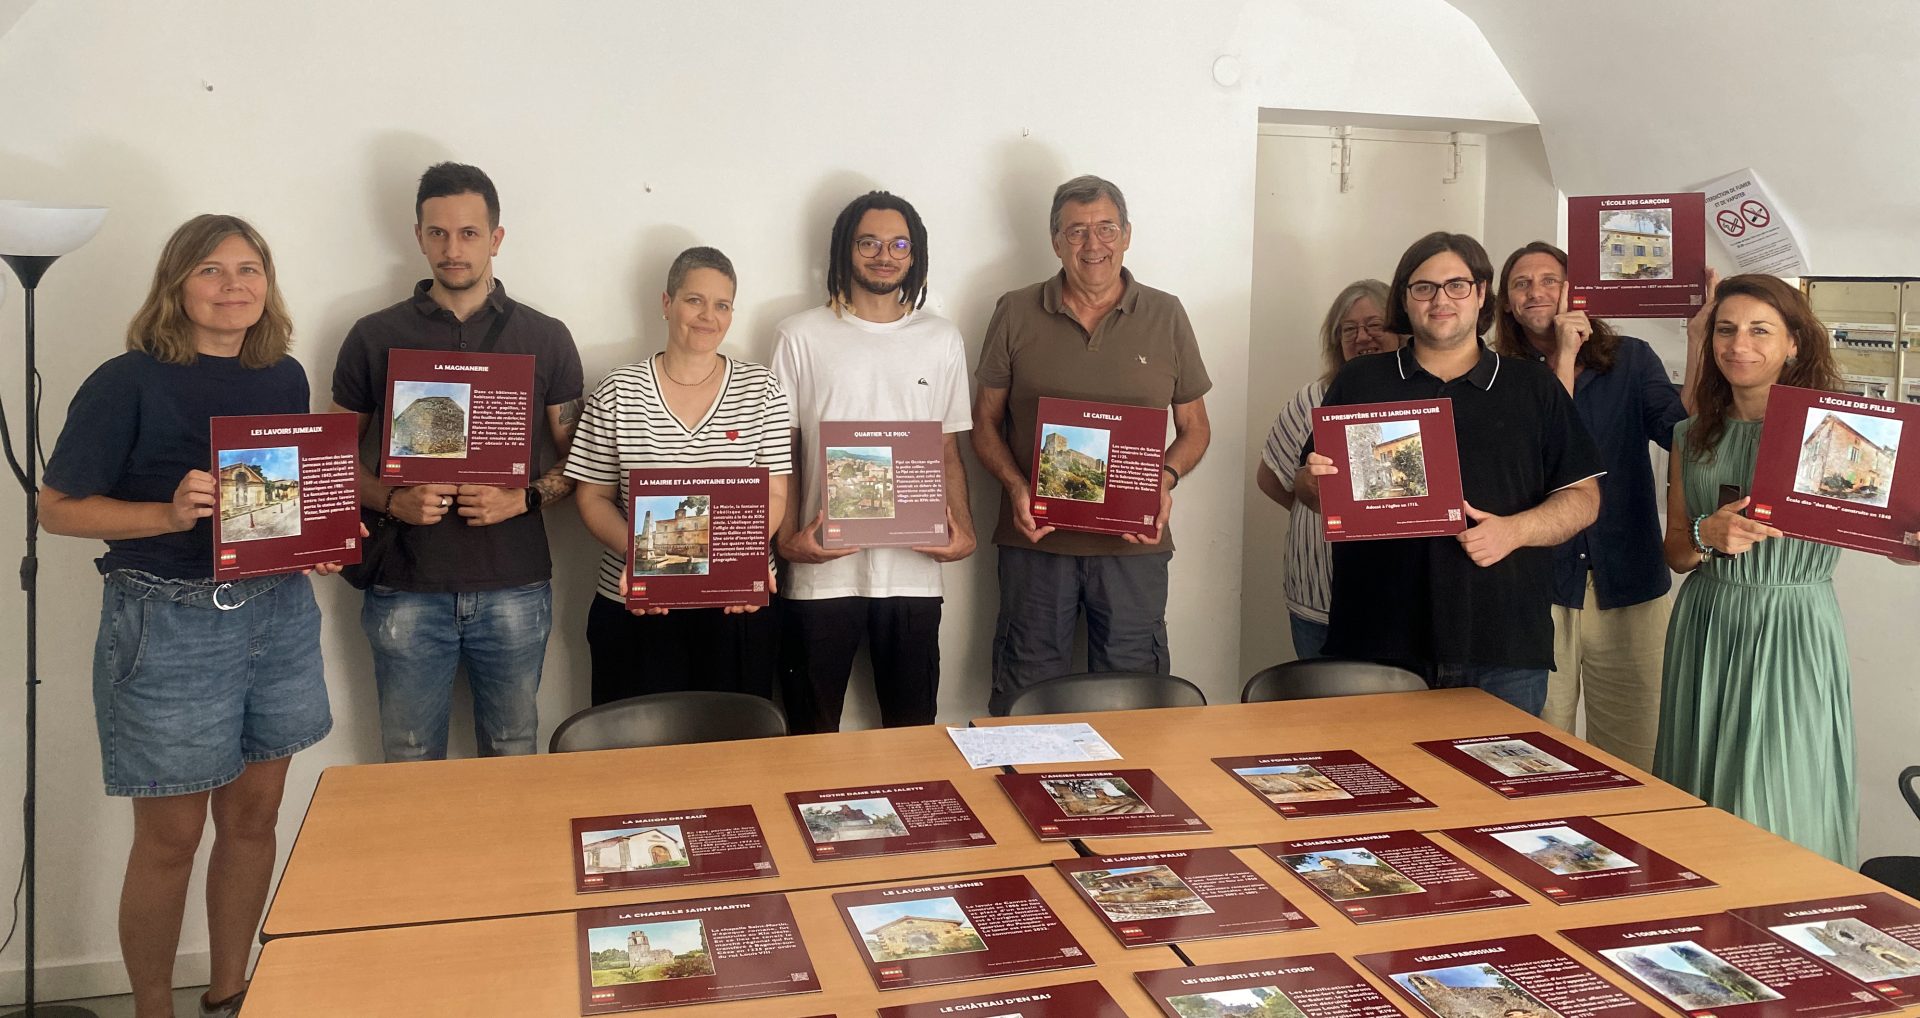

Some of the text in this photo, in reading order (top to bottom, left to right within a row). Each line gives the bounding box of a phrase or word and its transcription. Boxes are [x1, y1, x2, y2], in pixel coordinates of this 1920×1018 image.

[1705, 190, 1730, 204] TERDICTION
[1726, 192, 1745, 202] VAPOTER
[1820, 396, 1895, 413] L'ÉCOLE DES FILLES
[1091, 413, 1122, 421] CASTELLAS
[1331, 412, 1370, 421] PRESBYTÈRE
[1841, 506, 1869, 516] construite
[1474, 825, 1505, 833] L'ÉGLISE
[1304, 838, 1344, 846] CHAPELLE
[896, 887, 932, 895] LAVOIR
[947, 882, 984, 890] CANNES
[634, 909, 684, 918] CHAPELLE
[714, 903, 751, 912] MARTIN
[1796, 908, 1819, 917] SALLE
[1833, 904, 1868, 913] CONSULS
[1635, 930, 1659, 938] TOUR
[1414, 946, 1506, 962] L'ÉGLISE PAROISSIALE
[1199, 972, 1248, 983] REMPARTS
[1285, 966, 1315, 975] TOURS
[955, 998, 1004, 1011] CHÂTEAU
[1005, 996, 1031, 1005] D'EN
[1031, 993, 1051, 1002] BAS
